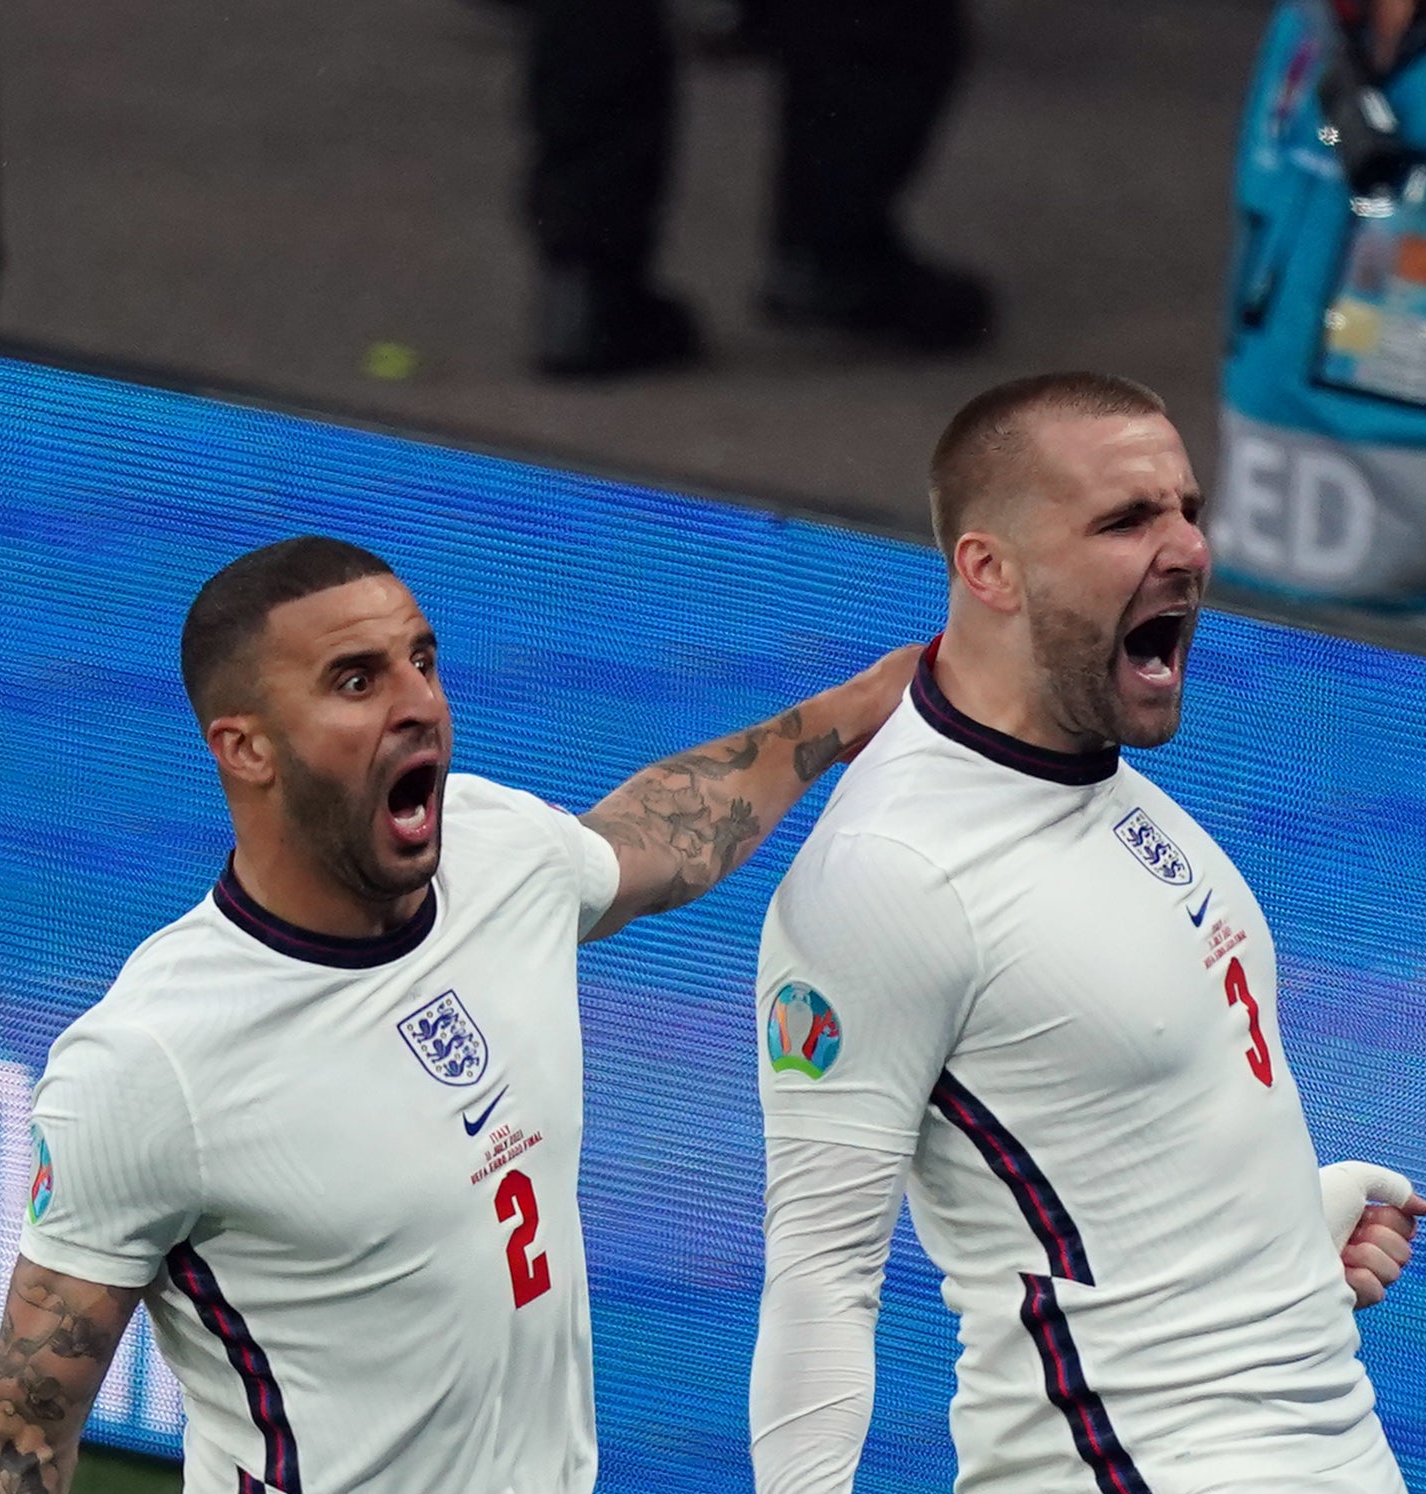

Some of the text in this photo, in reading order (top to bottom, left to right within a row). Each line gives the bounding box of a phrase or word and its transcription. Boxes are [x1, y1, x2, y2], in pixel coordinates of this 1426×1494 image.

[1211, 436, 1375, 580] ED
[1224, 956, 1274, 1088] 3
[470, 1167, 490, 1185] UEFA
[523, 1131, 543, 1150] FINAL
[489, 1124, 511, 1144] ITALY
[494, 1168, 552, 1310] 2
